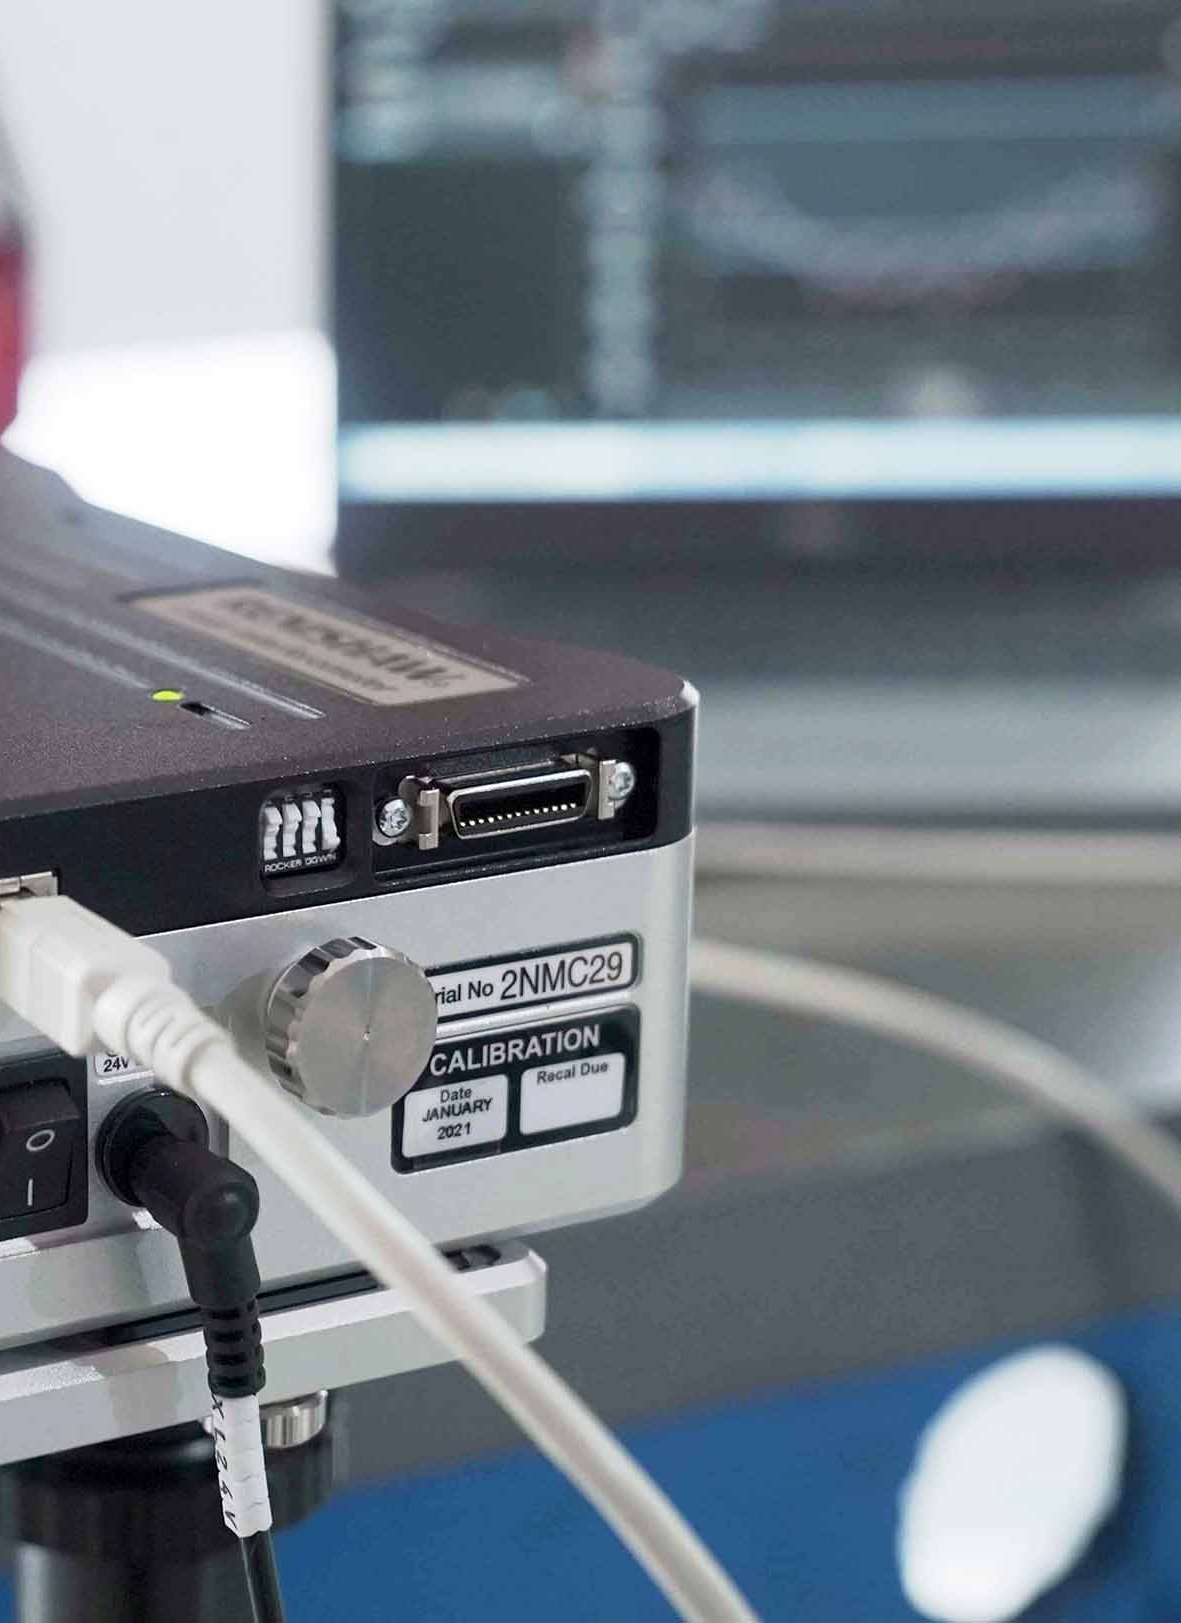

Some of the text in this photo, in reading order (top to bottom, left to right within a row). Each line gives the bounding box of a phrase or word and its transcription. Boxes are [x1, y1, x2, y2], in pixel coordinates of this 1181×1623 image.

[264, 853, 337, 873] ROCKER DOWN
[435, 951, 623, 1004] rial No 2NMC29
[429, 1024, 600, 1076] CALIBRATION
[103, 1056, 130, 1073] 24V
[537, 1061, 609, 1085] Recal Due
[440, 1086, 473, 1104] Date
[422, 1098, 493, 1122] JANUARY
[437, 1122, 471, 1140] 2021
